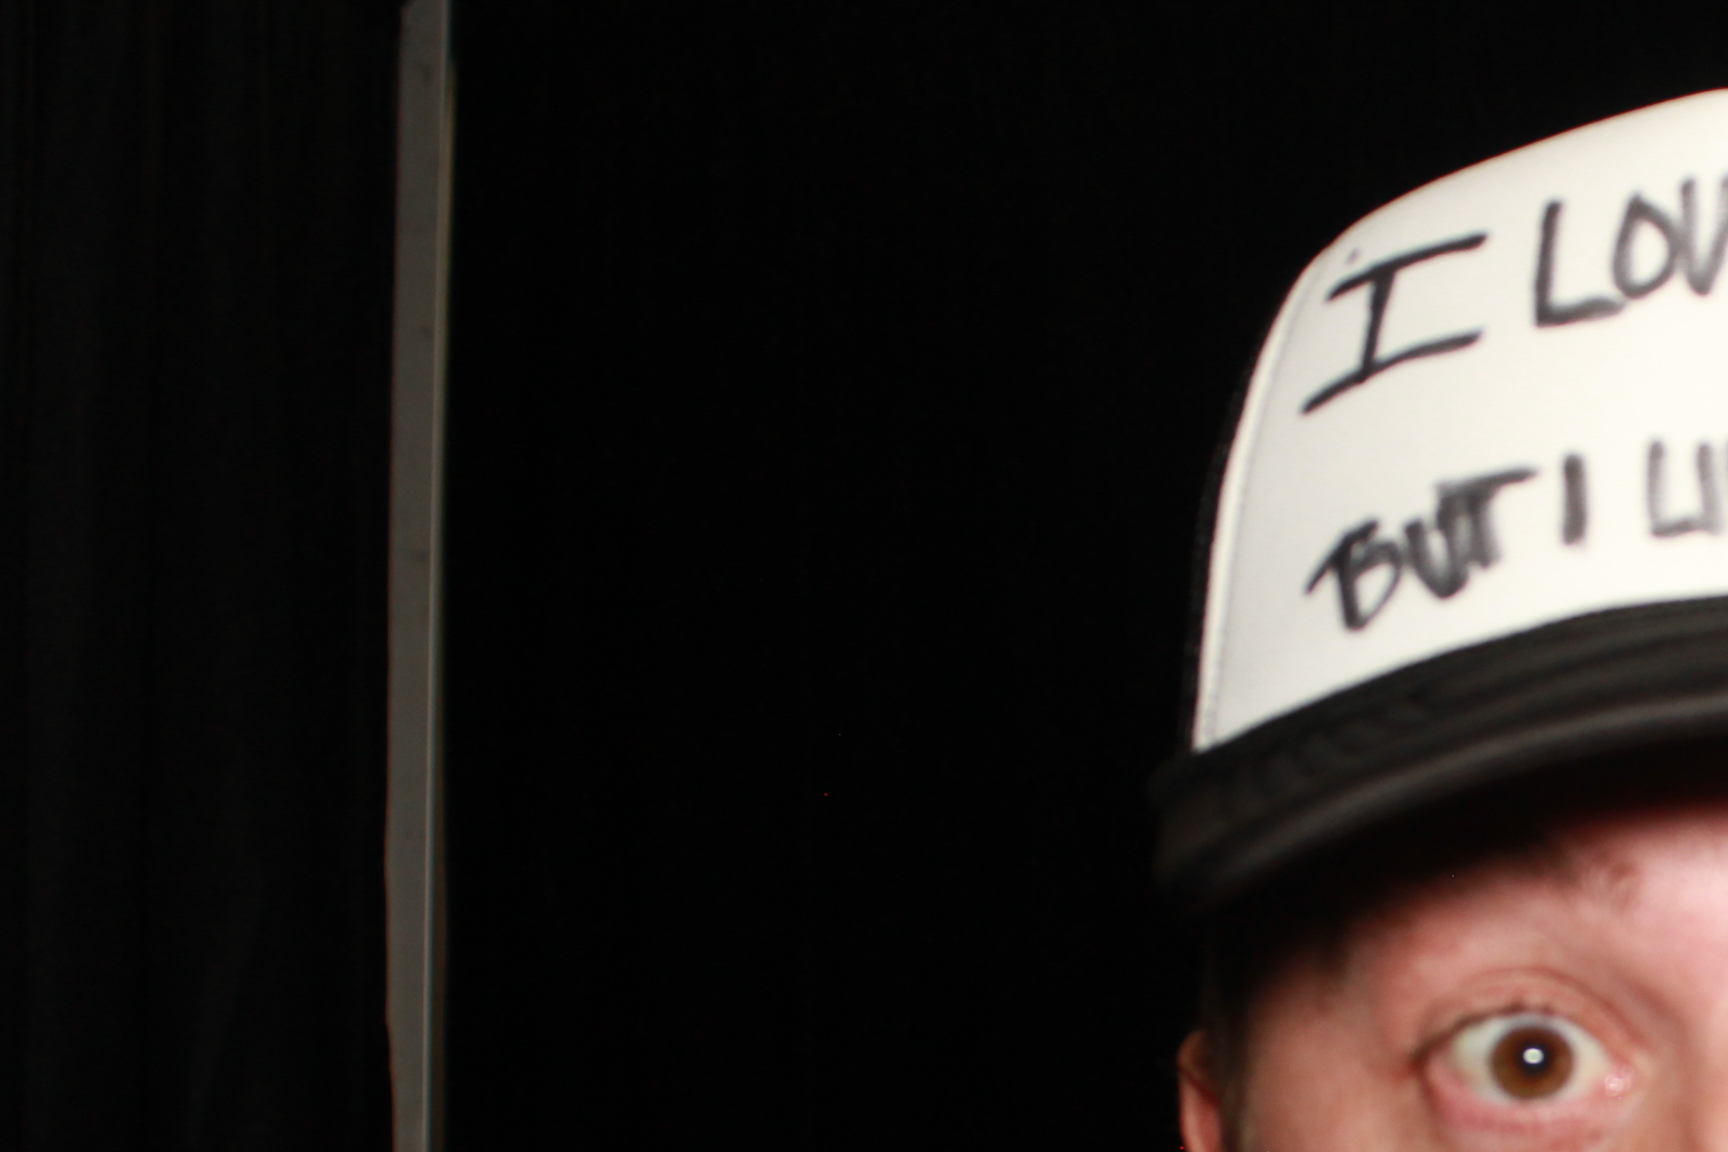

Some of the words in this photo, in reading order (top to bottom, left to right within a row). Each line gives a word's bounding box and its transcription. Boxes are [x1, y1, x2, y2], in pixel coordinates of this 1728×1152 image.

[1300, 229, 1489, 416] I
[1304, 467, 1538, 633] BUT
[1561, 453, 1588, 545] I
